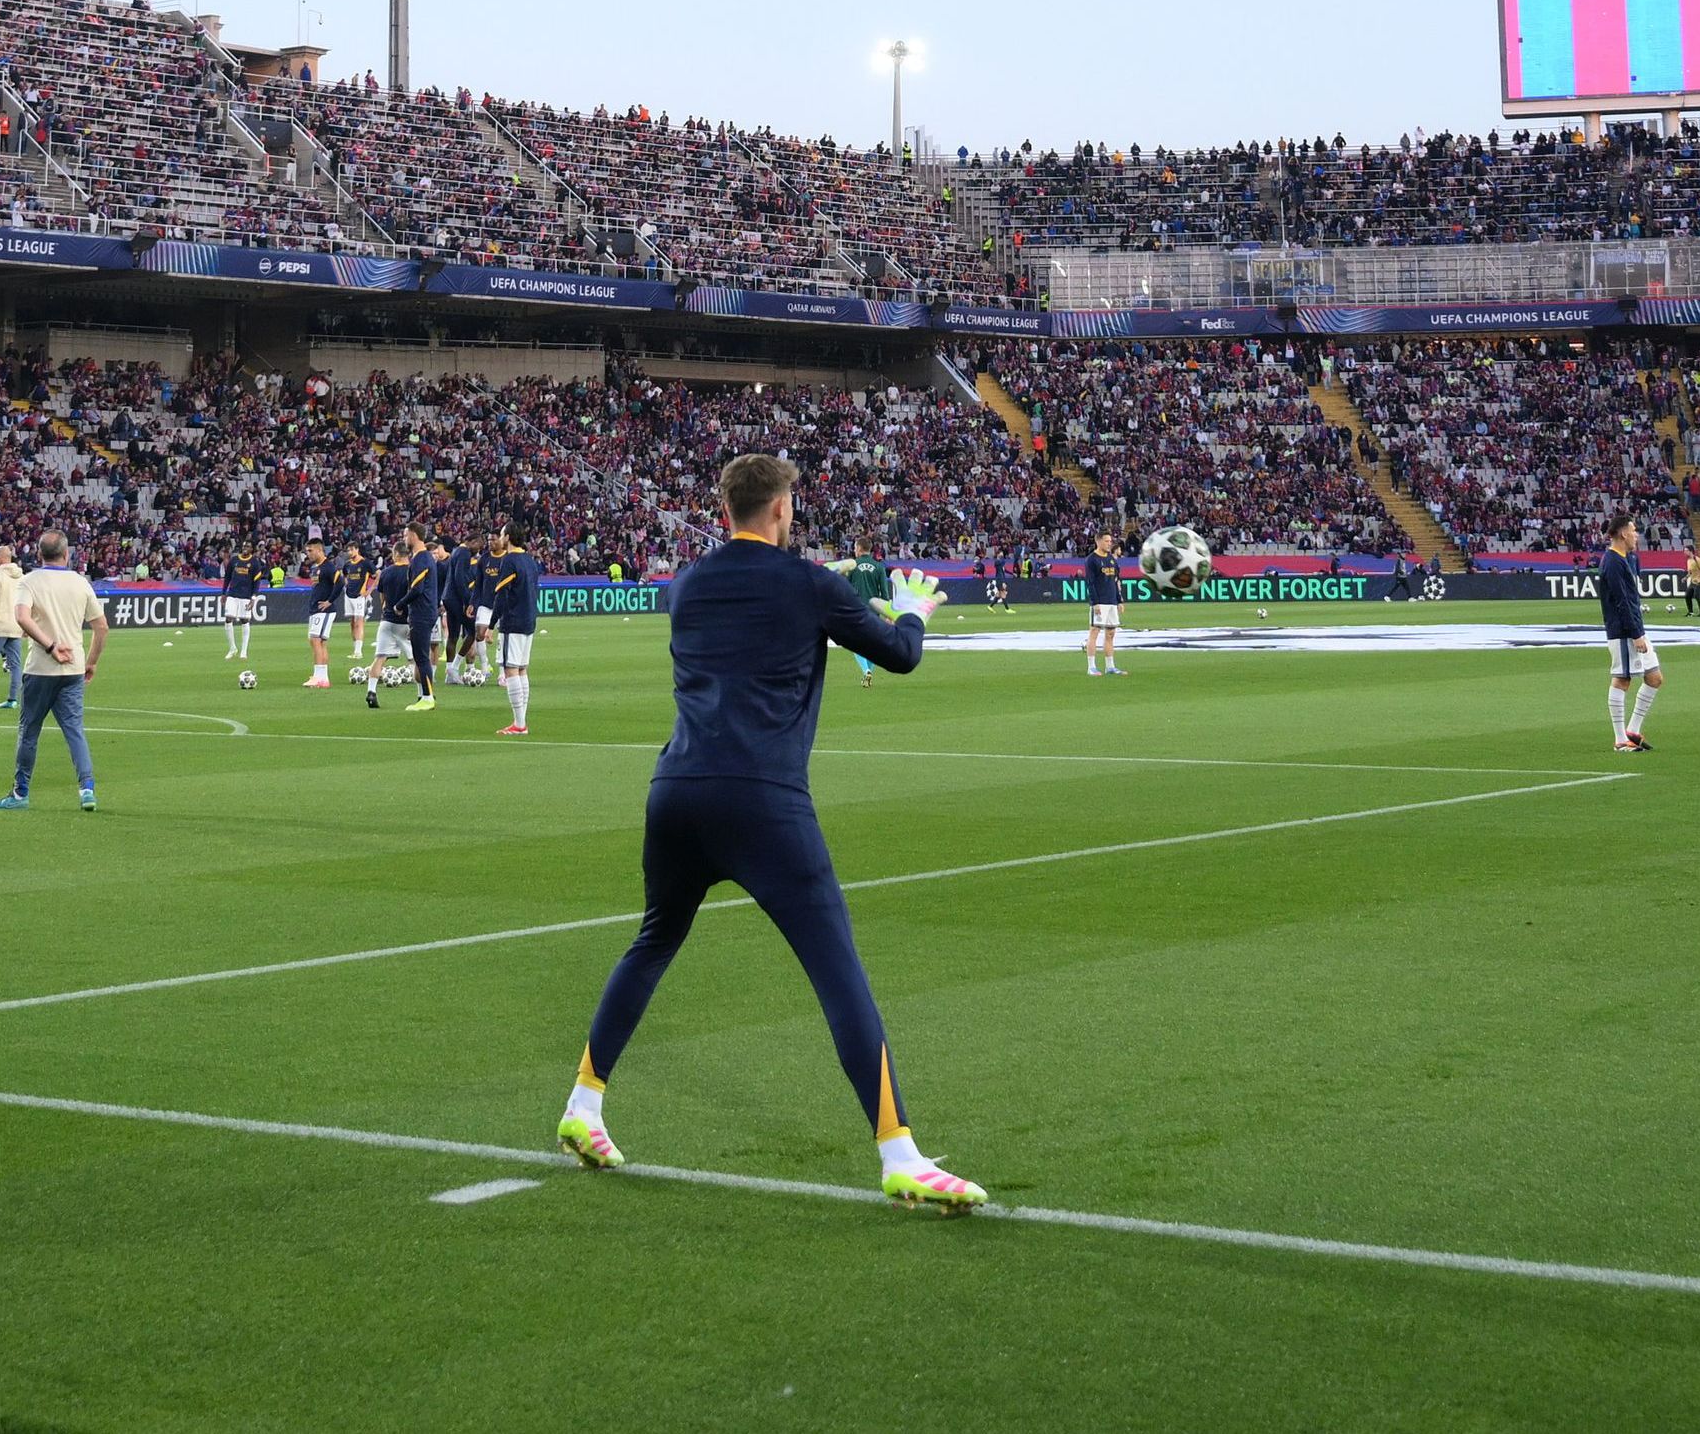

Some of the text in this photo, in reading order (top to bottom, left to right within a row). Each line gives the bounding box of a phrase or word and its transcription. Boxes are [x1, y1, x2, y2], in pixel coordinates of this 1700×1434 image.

[8, 239, 56, 255] LEAGUE
[278, 262, 310, 274] PEPSI
[490, 277, 616, 298] UEFA CHAMPIONS LEAGUE
[787, 303, 809, 313] QATAR
[944, 312, 1040, 329] UEFA CHAMPIONS LEAGUE
[1430, 310, 1590, 325] UEFA CHAMPIONS LEAGUE
[1062, 577, 1367, 601] NITS NEVER FORGET
[1546, 576, 1601, 597] THA
[593, 587, 659, 612] FORGET
